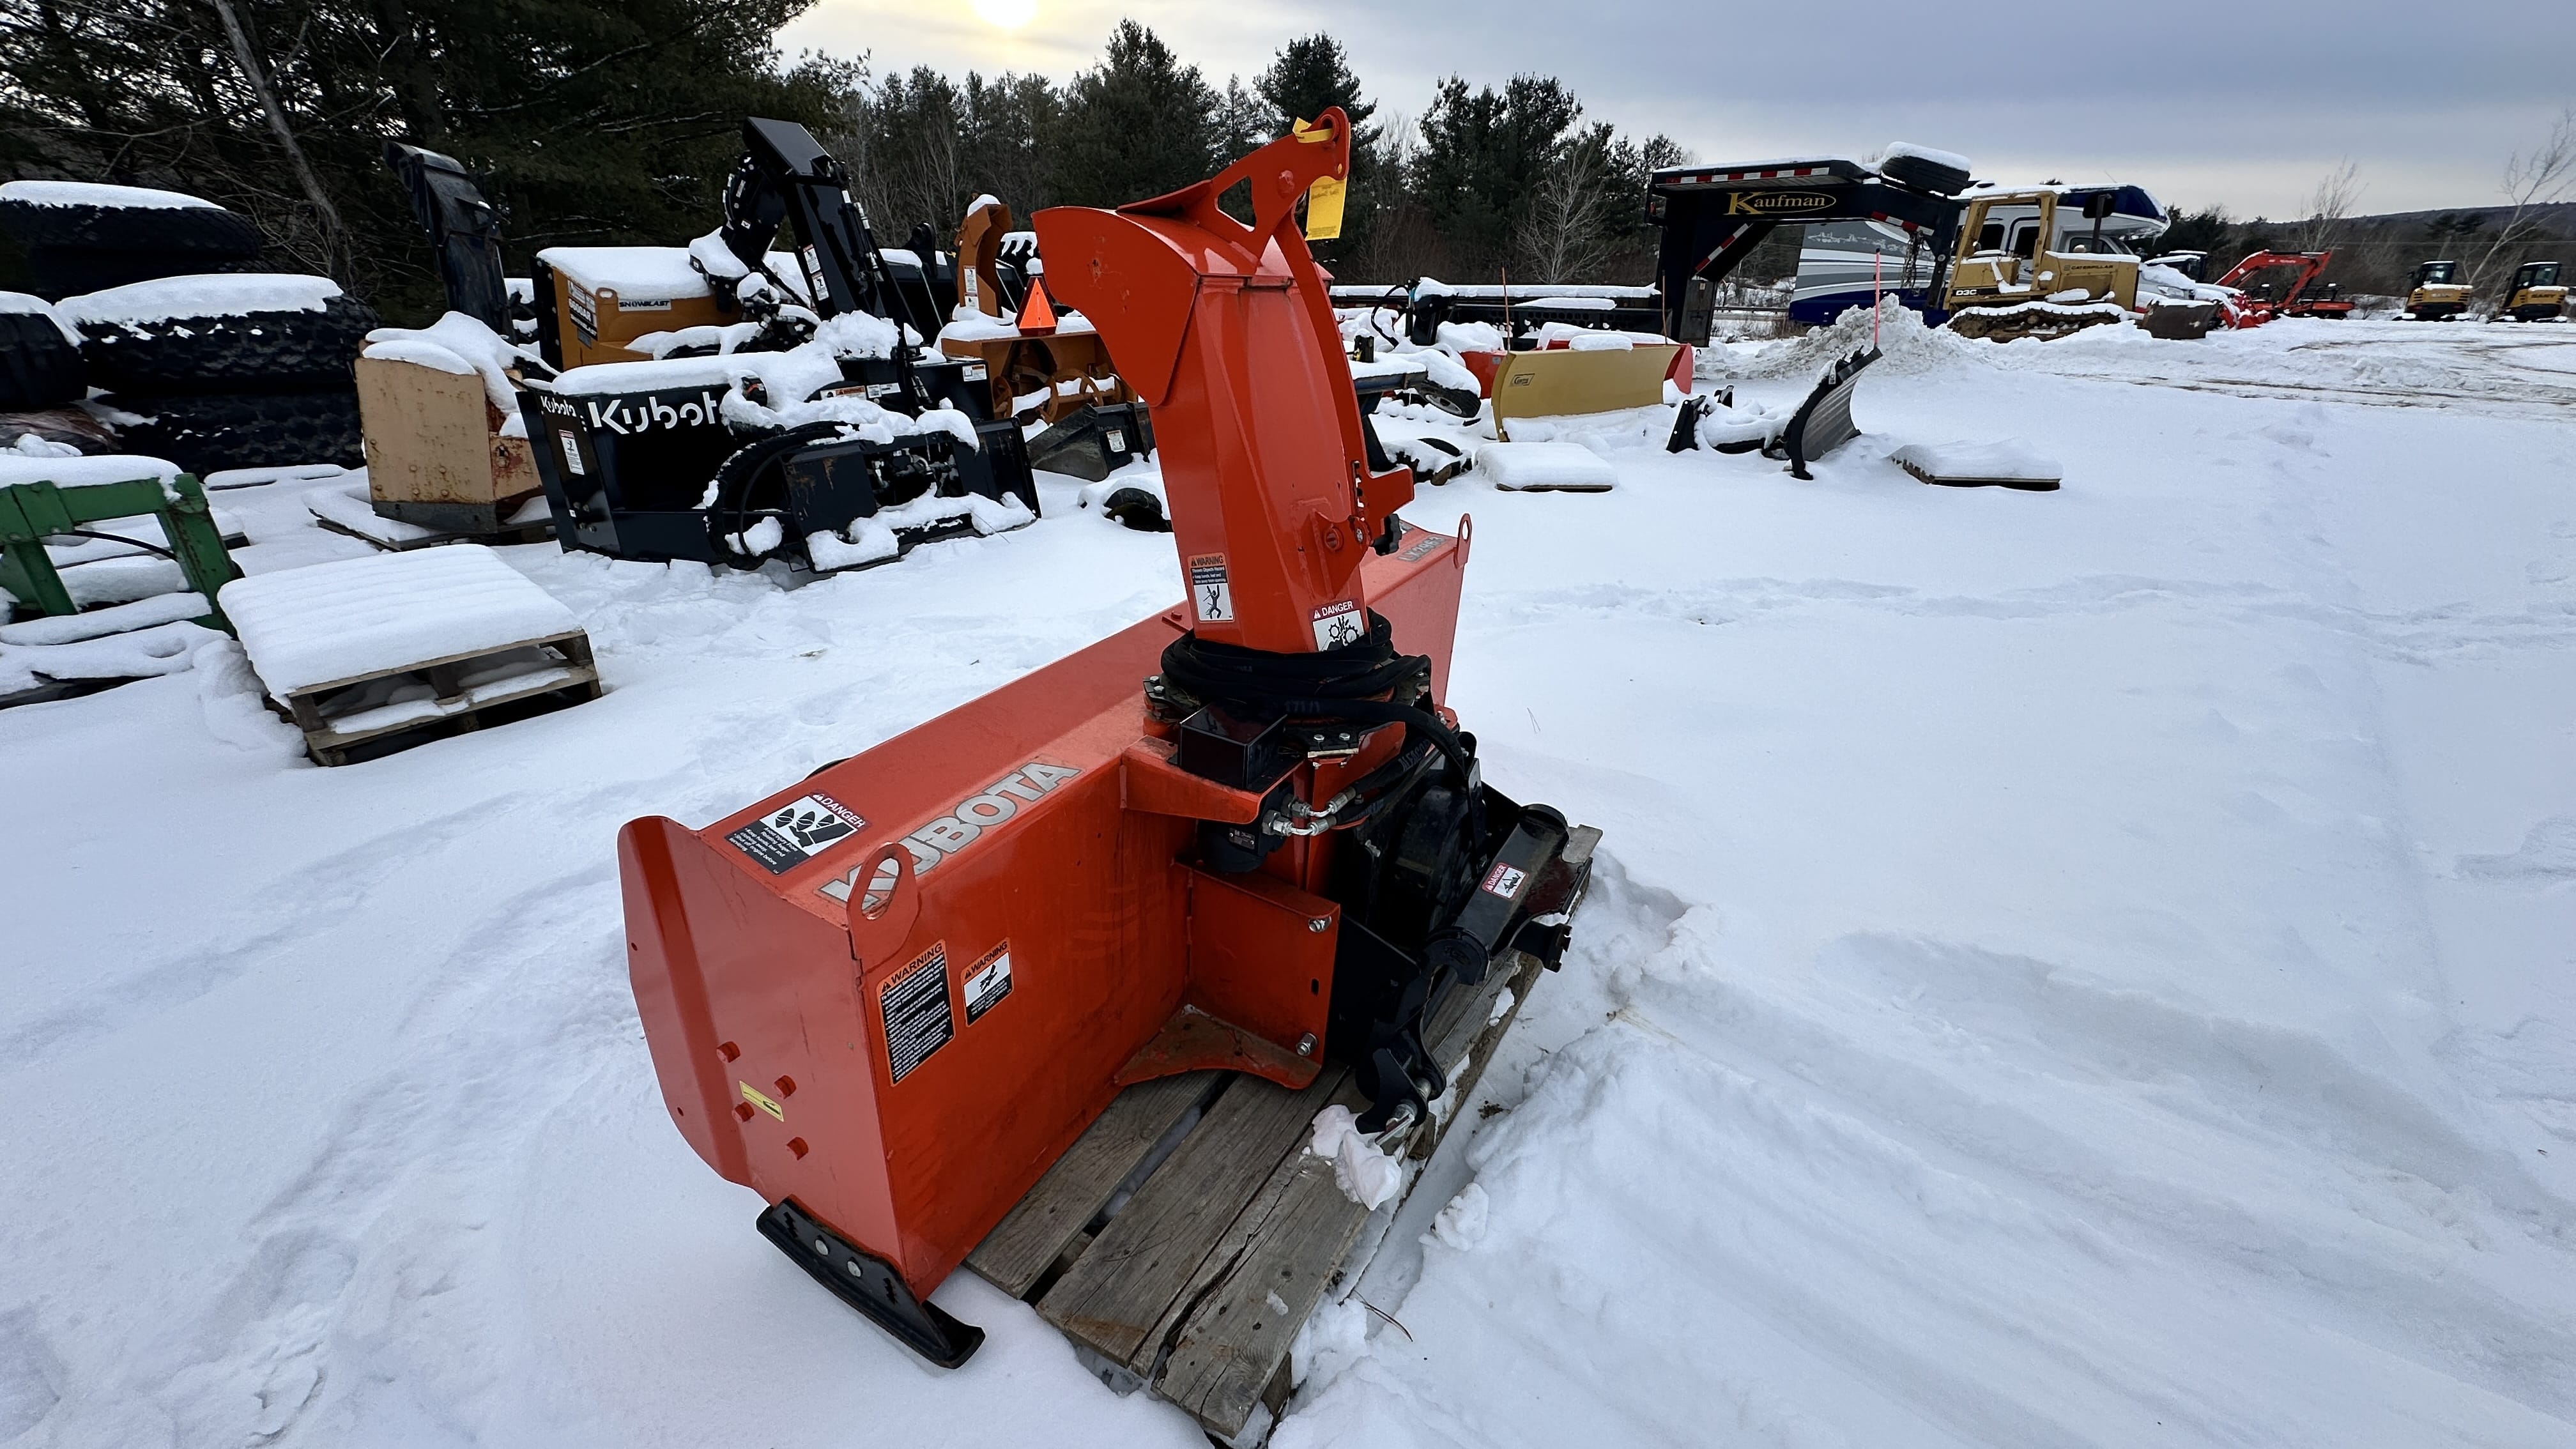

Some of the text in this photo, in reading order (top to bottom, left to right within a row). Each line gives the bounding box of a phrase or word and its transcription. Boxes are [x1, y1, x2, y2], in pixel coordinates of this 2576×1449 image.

[1723, 192, 1825, 215] Kaufman
[540, 395, 576, 417] Kubota
[587, 391, 717, 434] Kubot
[1197, 555, 1223, 566] WARNING
[1397, 537, 1444, 561] LX2963
[1322, 601, 1353, 617] DANGER
[822, 797, 866, 828] DANGER
[1488, 864, 1507, 885] DANGER
[891, 942, 943, 984] WARNING
[971, 941, 1008, 973] WARNING
